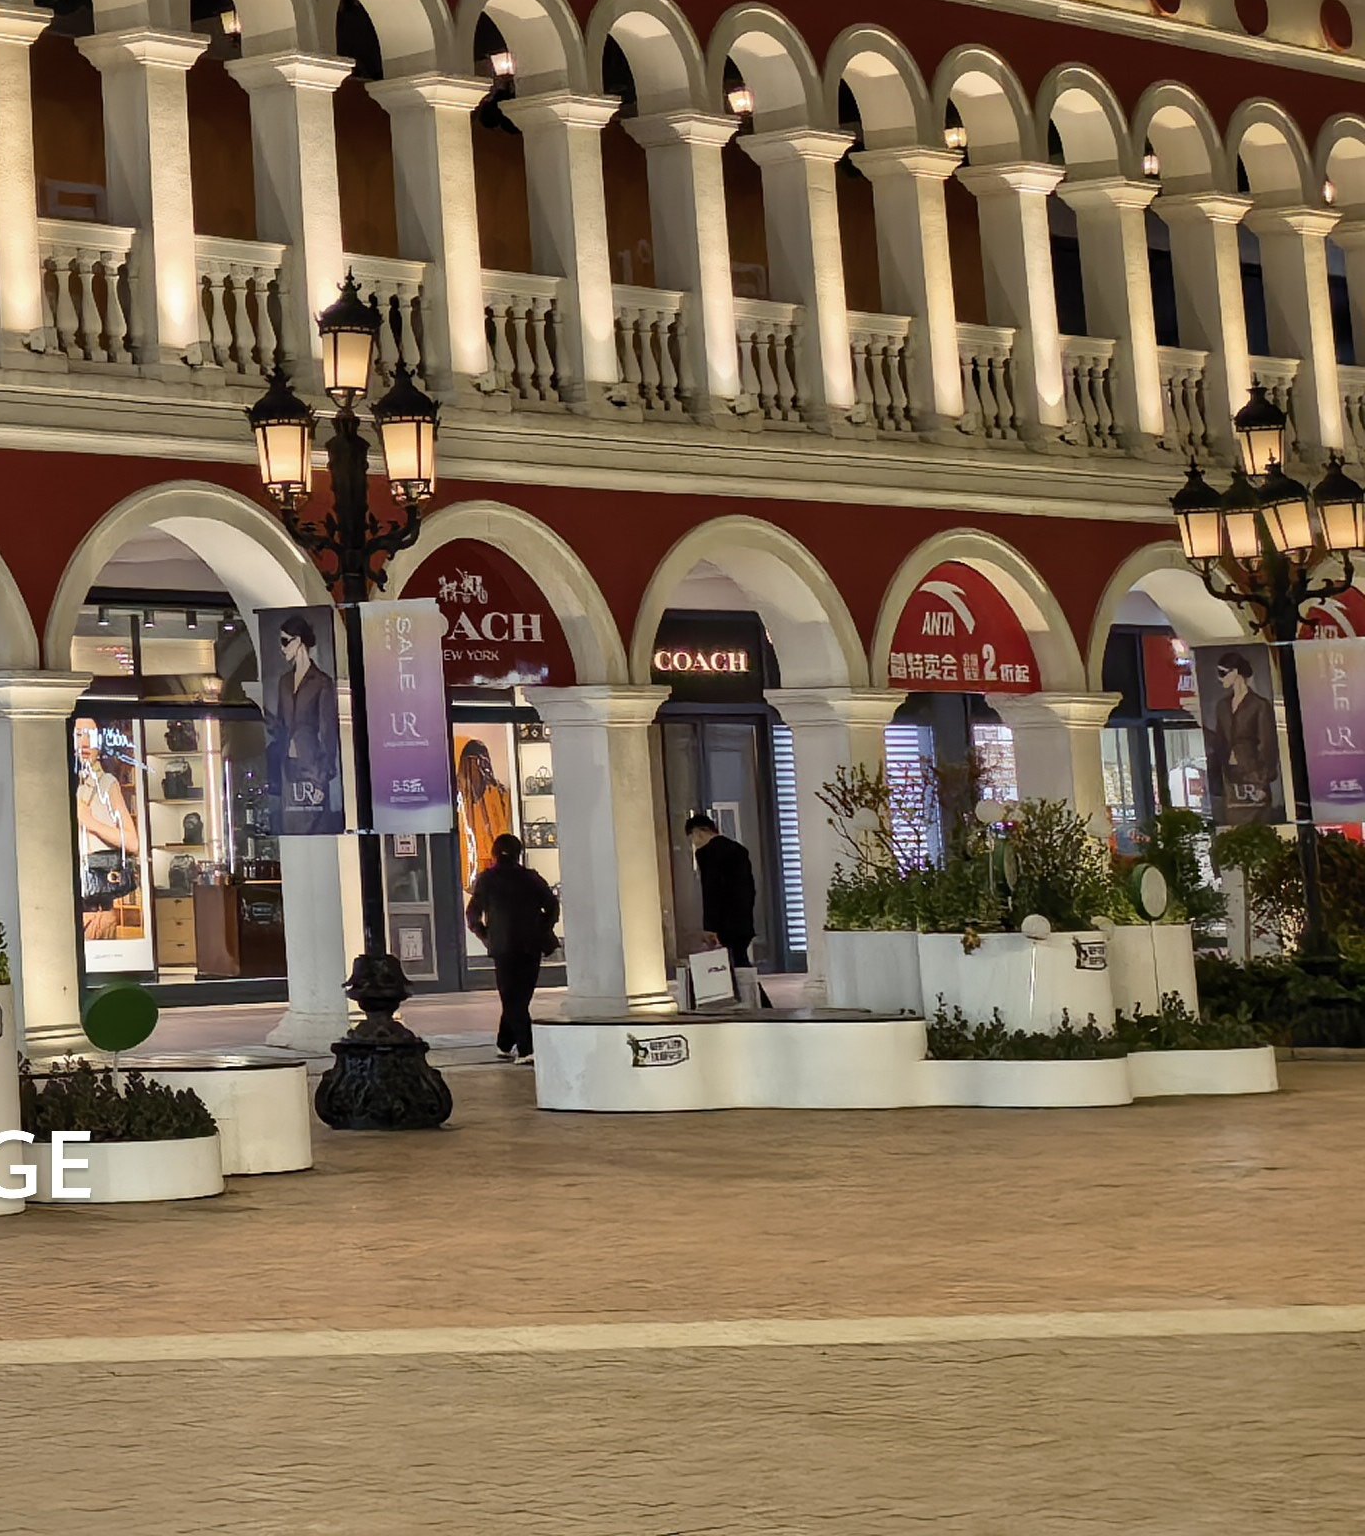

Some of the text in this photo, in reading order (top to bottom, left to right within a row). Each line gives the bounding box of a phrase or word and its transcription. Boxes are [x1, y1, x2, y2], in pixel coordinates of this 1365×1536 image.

[447, 611, 545, 643] ACH
[921, 611, 956, 637] ANTA
[396, 616, 417, 692] SALE
[442, 649, 500, 661] EW YORK
[654, 650, 750, 672] COACH
[390, 712, 421, 738] UR
[1326, 726, 1356, 749] UR
[292, 781, 316, 806] UR
